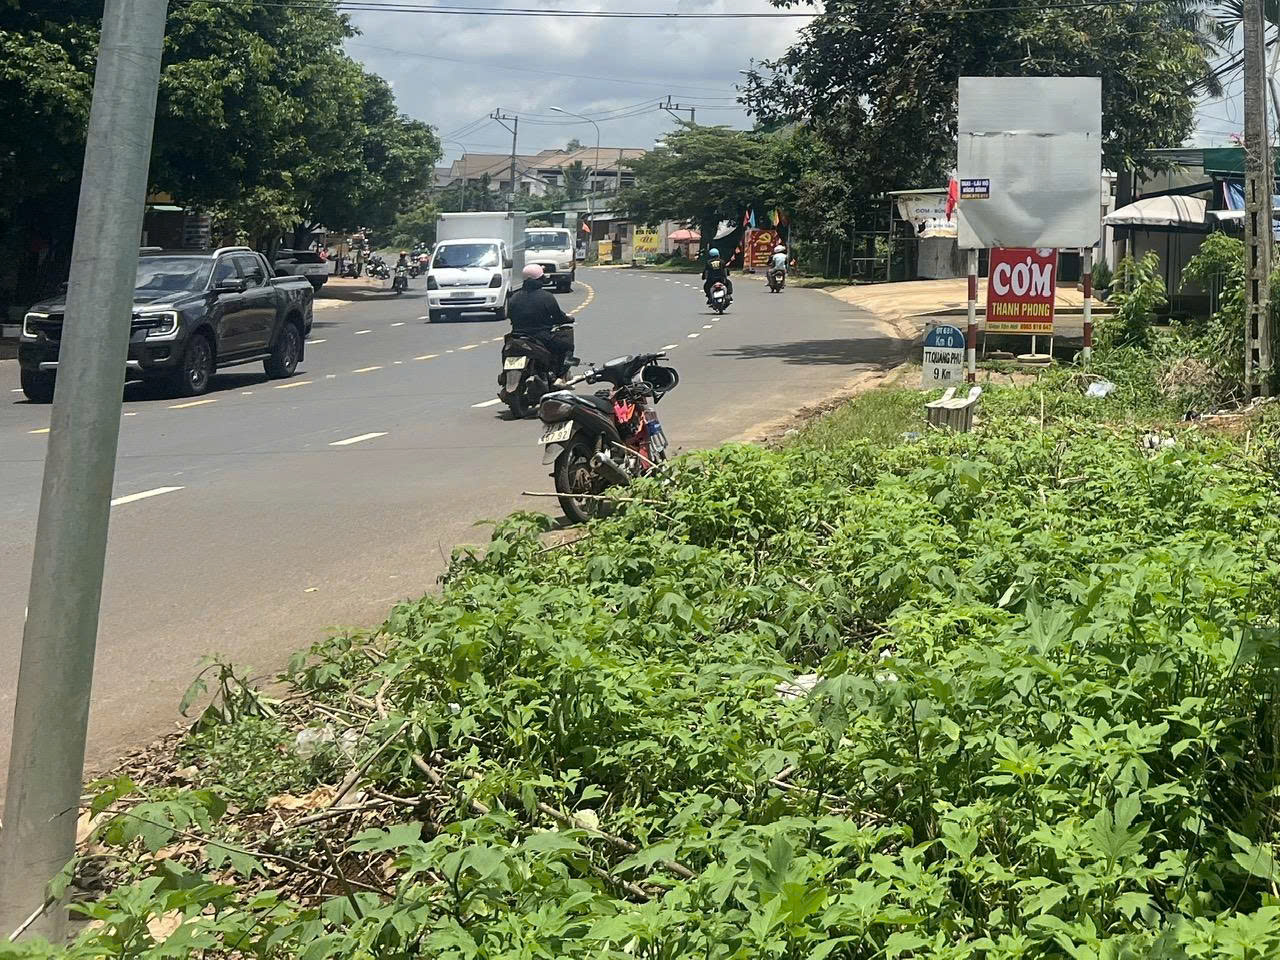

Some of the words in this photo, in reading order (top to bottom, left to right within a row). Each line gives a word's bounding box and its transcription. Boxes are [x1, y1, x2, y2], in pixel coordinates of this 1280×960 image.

[993, 256, 1053, 298] CƠM
[992, 302, 1020, 316] THANH
[1021, 303, 1050, 317] PHONG
[935, 335, 945, 346] Km
[947, 336, 954, 347] 0
[933, 367, 940, 380] 9
[941, 368, 951, 380] Km
